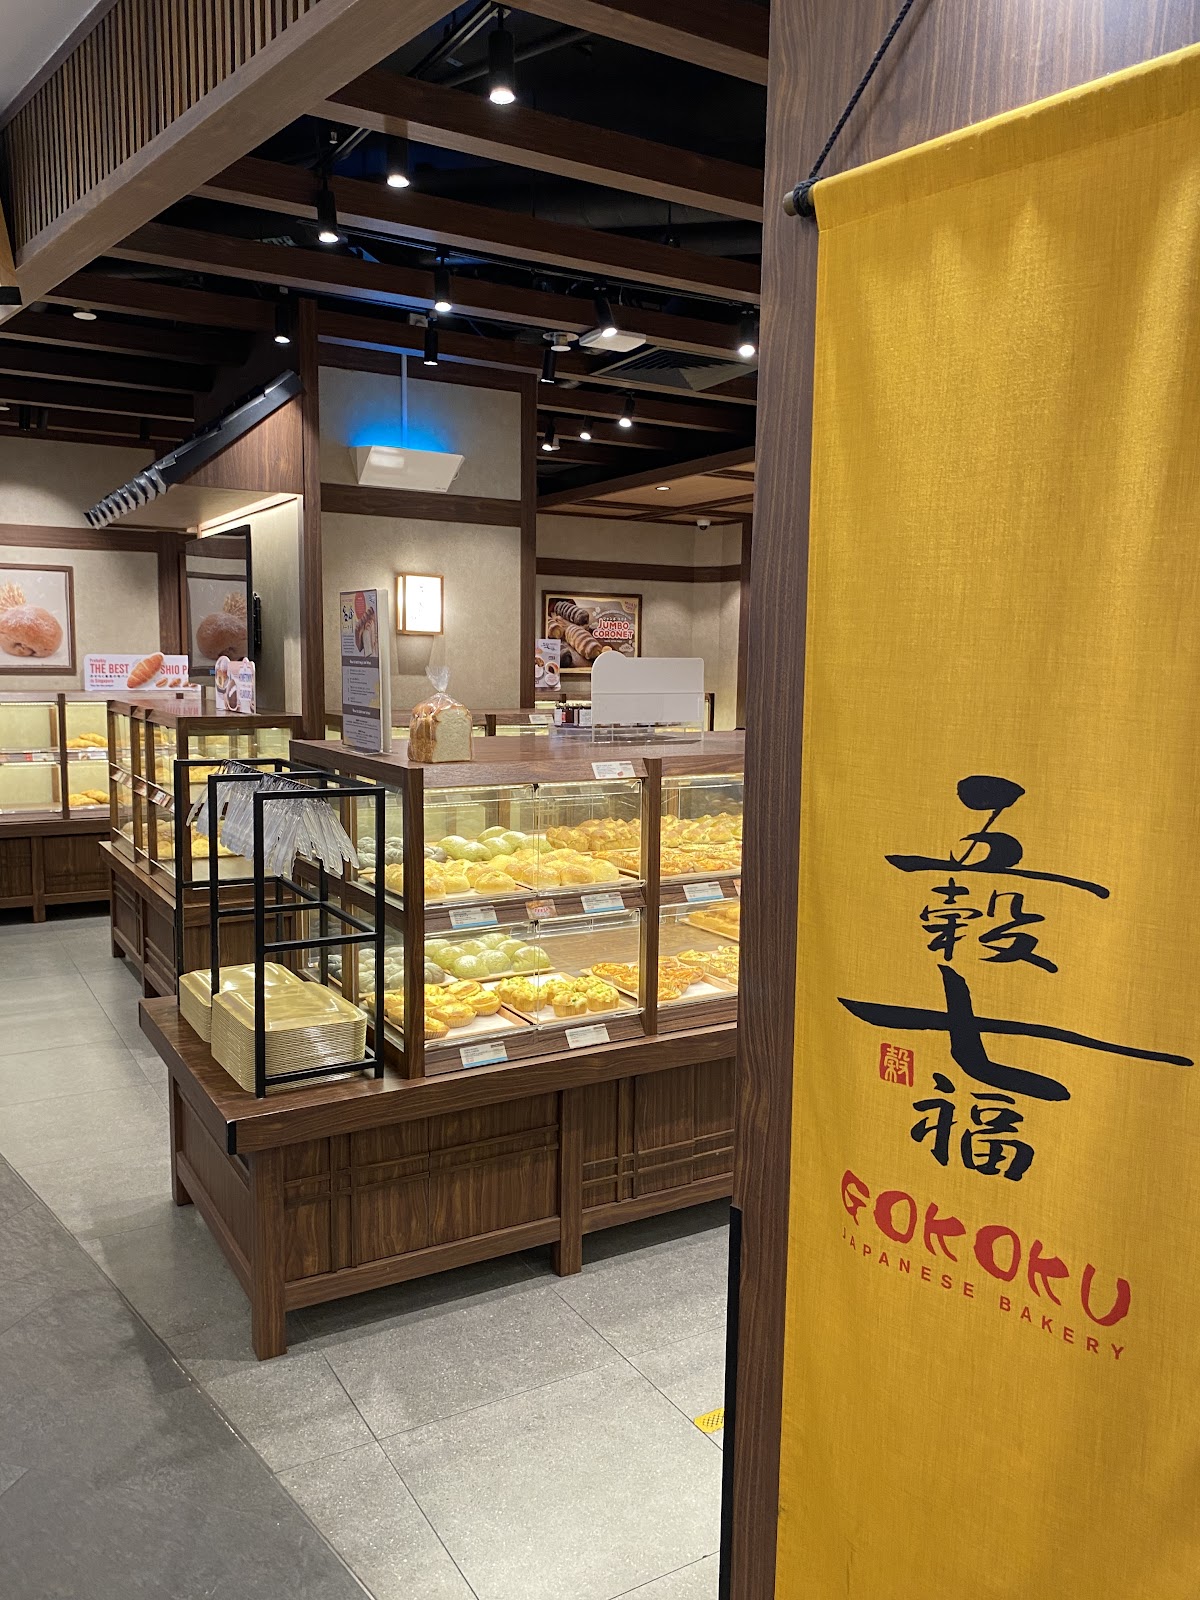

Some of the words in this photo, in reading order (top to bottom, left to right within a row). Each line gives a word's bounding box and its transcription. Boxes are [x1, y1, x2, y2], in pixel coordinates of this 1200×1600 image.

[598, 619, 629, 630] JUMBO
[593, 630, 634, 639] CORONET
[90, 663, 106, 674] THE
[108, 663, 129, 674] BEST
[160, 664, 180, 675] SHIO
[841, 1169, 1131, 1326] GOKOKU
[842, 1226, 975, 1298] JAPANESE
[999, 1295, 1124, 1360] BAKERY
